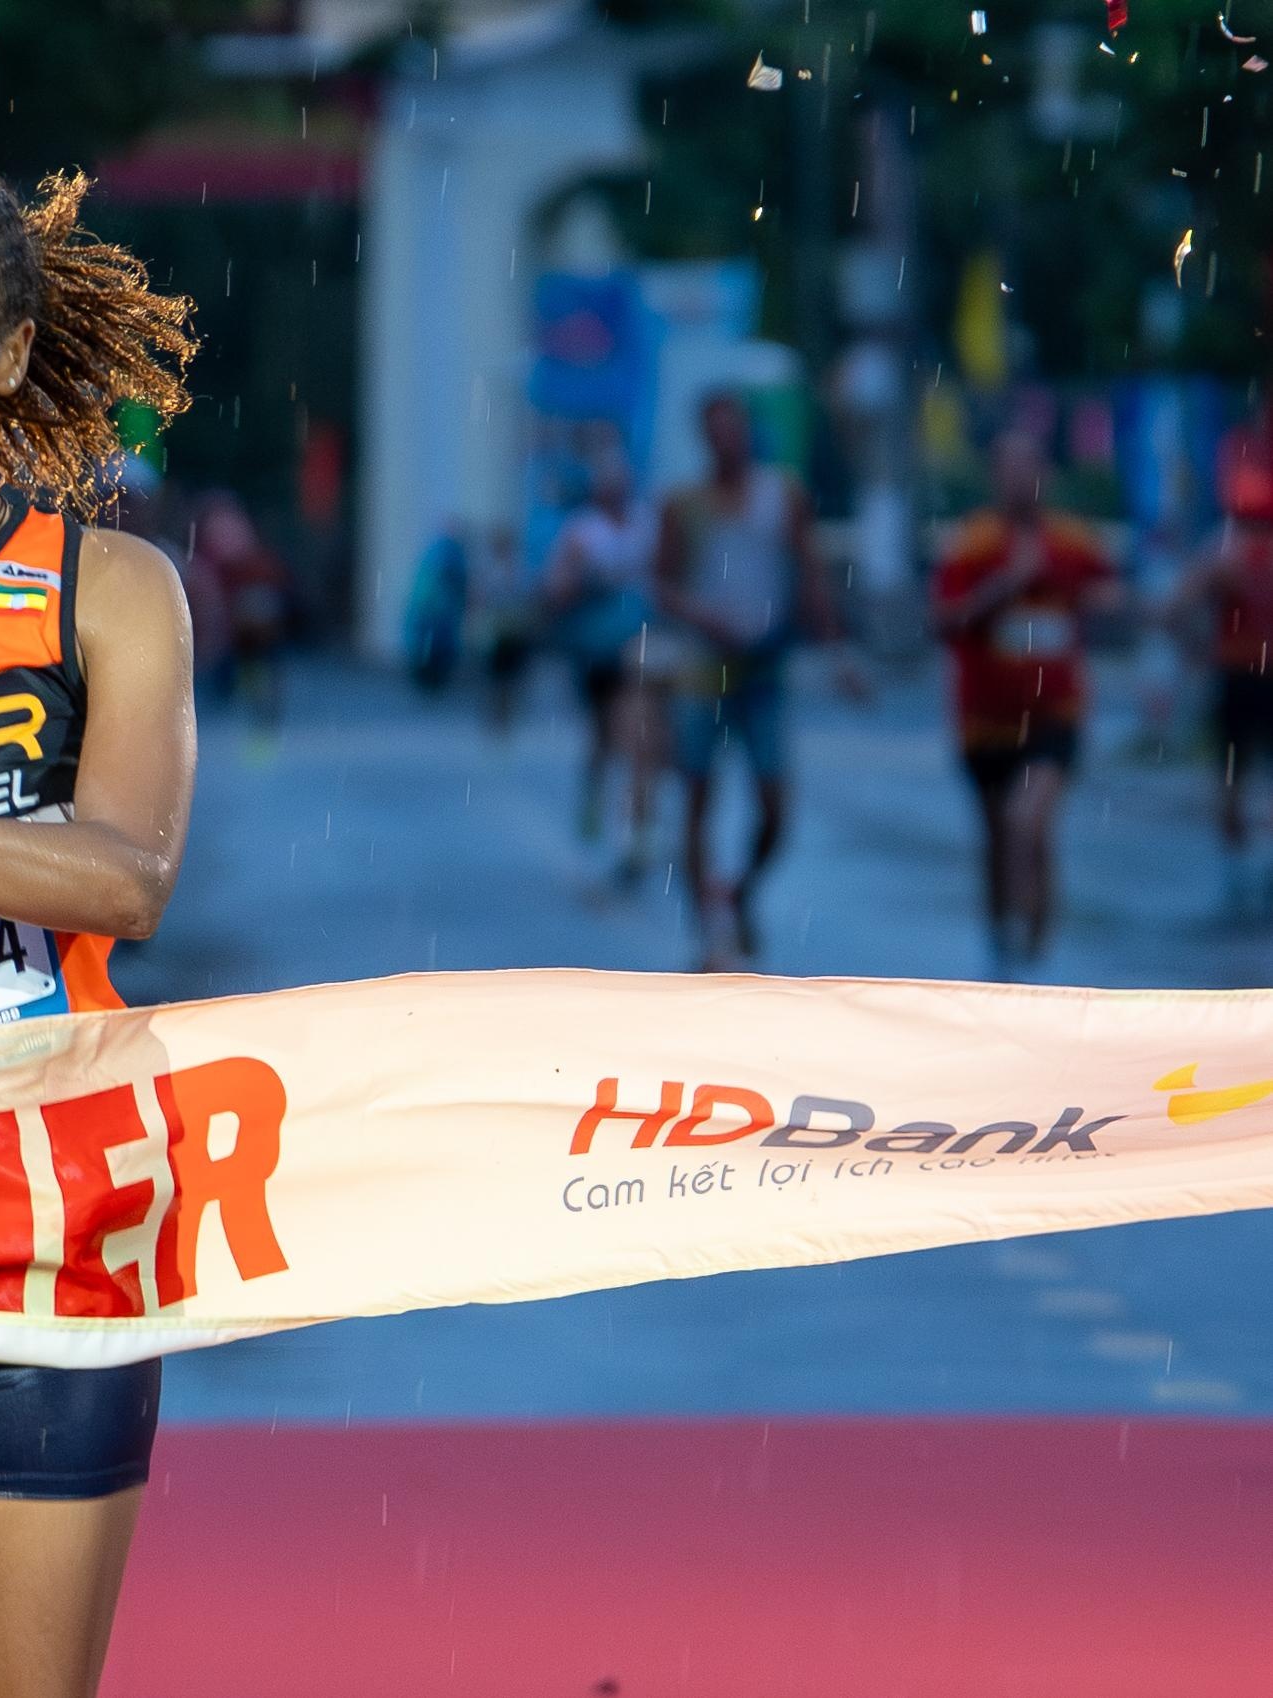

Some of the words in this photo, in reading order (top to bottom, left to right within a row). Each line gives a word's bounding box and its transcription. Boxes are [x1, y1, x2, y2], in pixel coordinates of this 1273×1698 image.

[569, 1078, 1131, 1155] HDBank
[563, 1176, 645, 1212] Cam
[669, 1161, 735, 1198] kết
[758, 1159, 814, 1191] lợi
